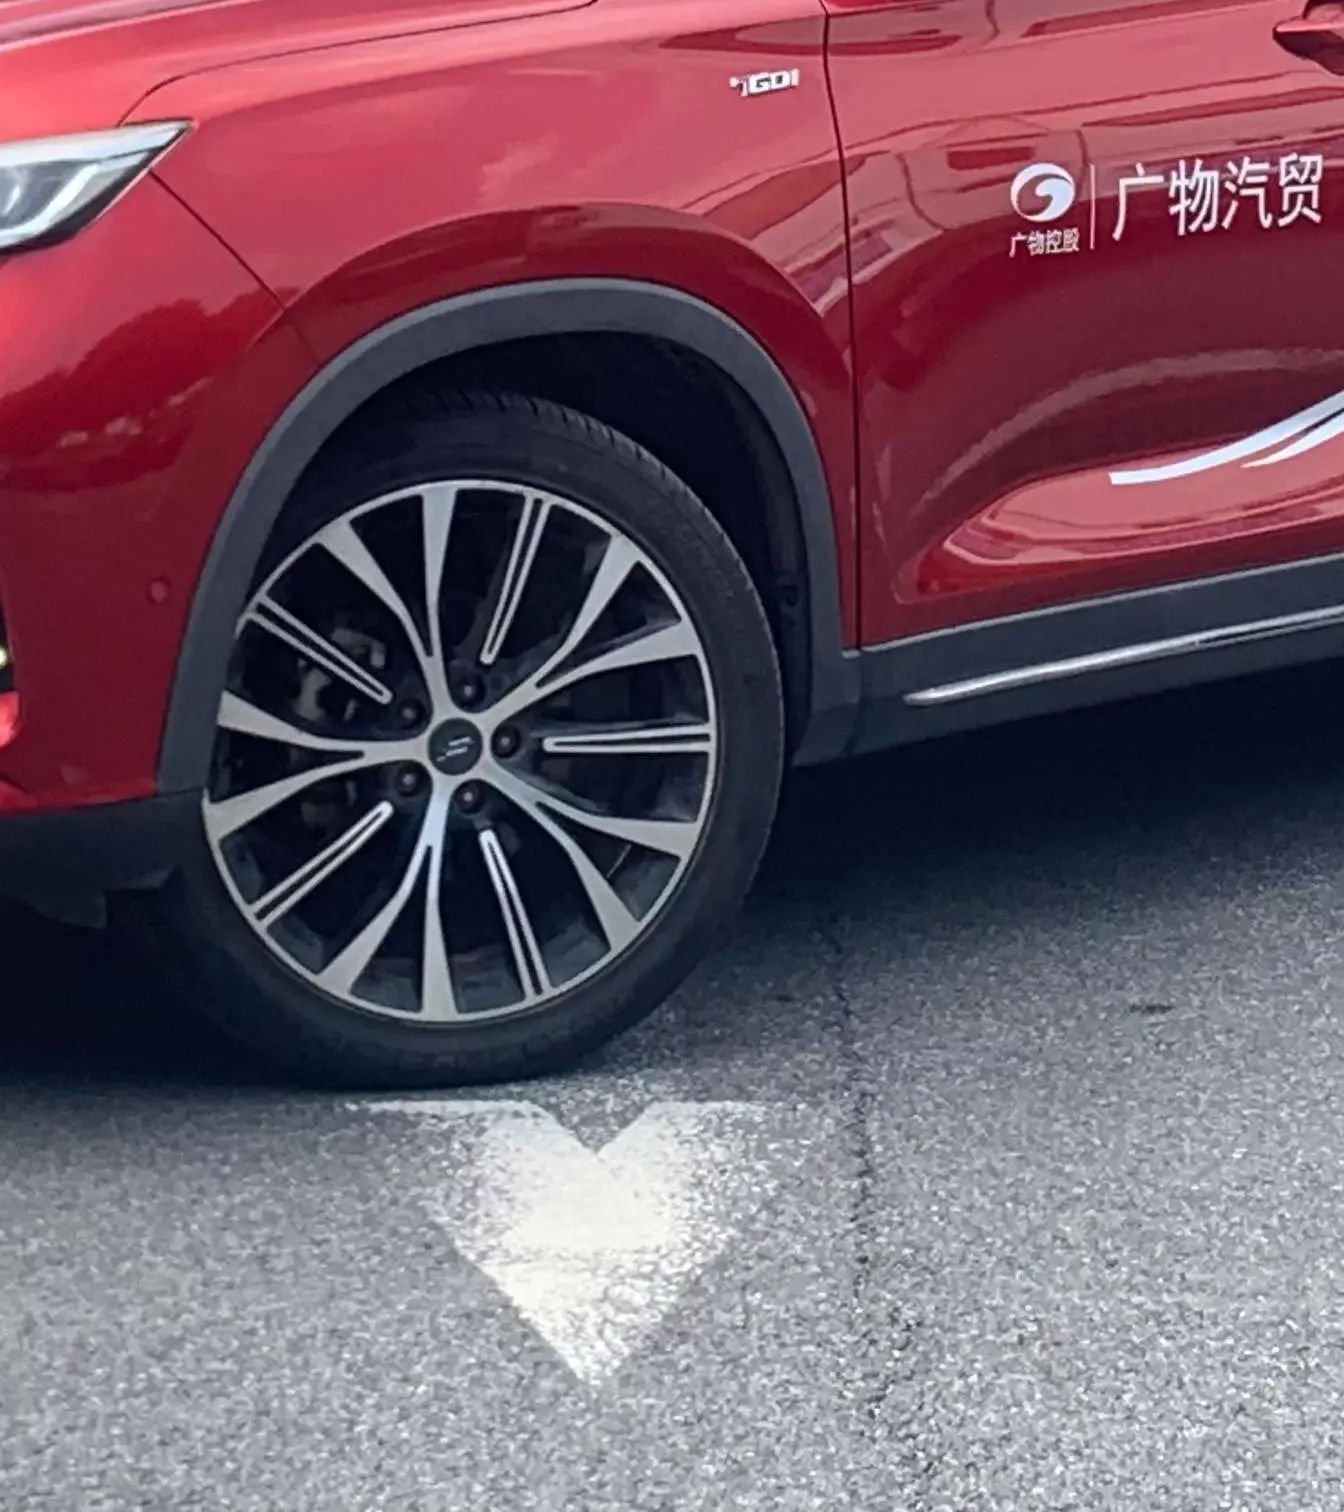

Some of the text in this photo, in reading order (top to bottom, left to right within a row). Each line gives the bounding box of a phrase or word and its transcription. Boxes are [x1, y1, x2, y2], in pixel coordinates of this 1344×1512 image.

[1111, 152, 1324, 241] 广物汽贸
[1009, 228, 1080, 258] 广物控股
